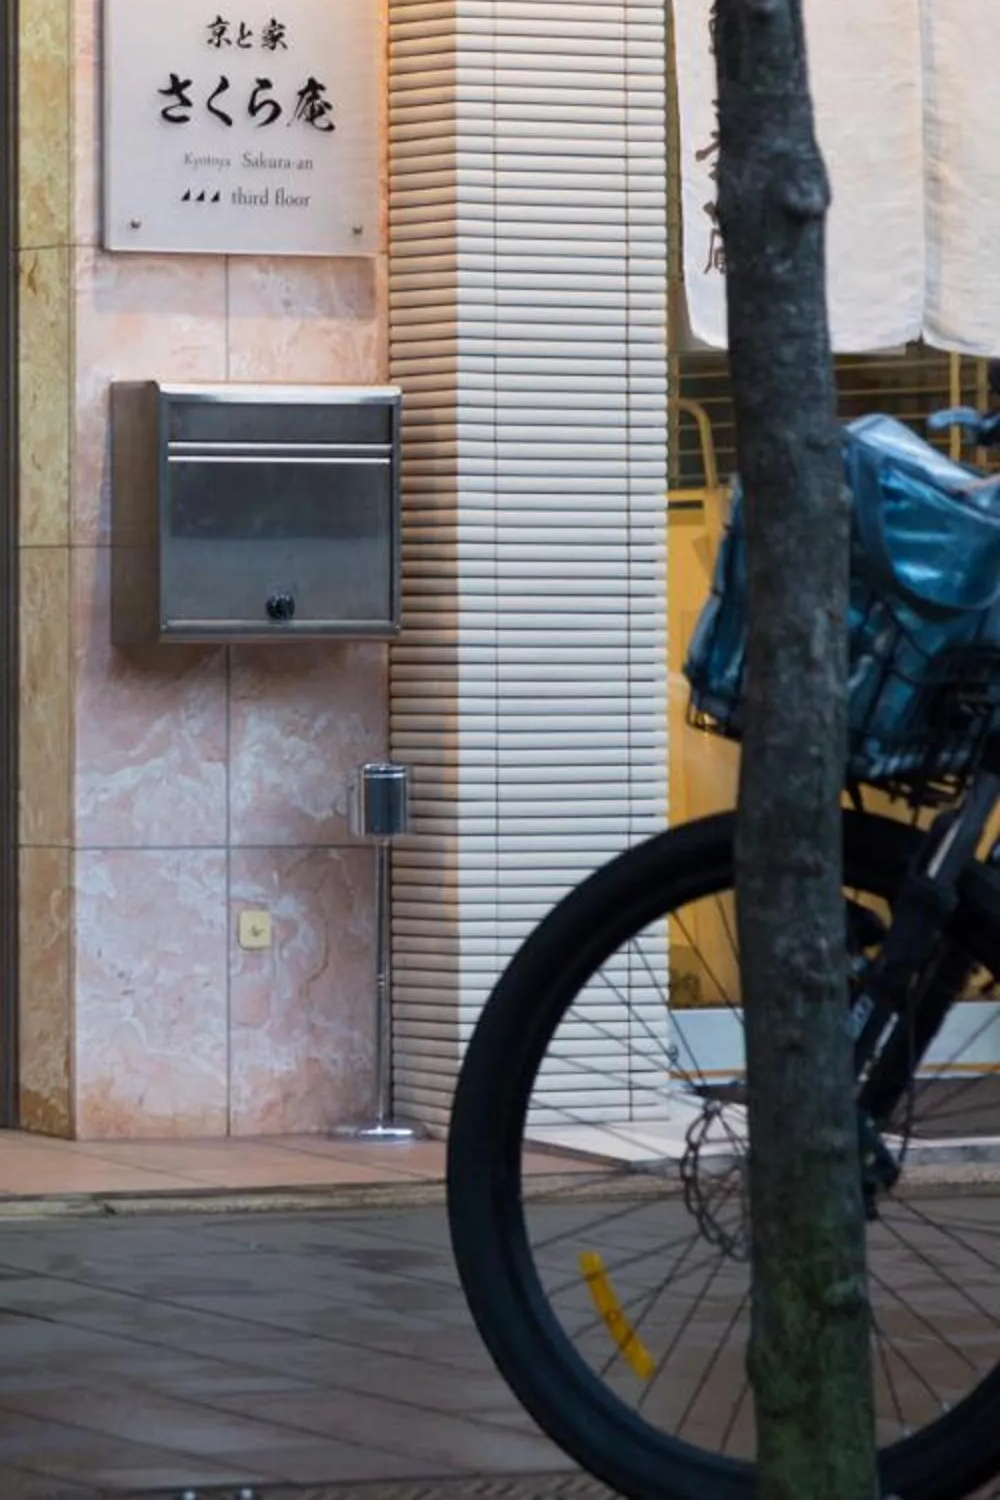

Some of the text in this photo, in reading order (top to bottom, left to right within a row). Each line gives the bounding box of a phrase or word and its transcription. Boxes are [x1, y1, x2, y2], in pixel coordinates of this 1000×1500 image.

[206, 14, 288, 51] 京と家
[157, 73, 336, 133] さくら庵
[231, 186, 311, 207] third floor
